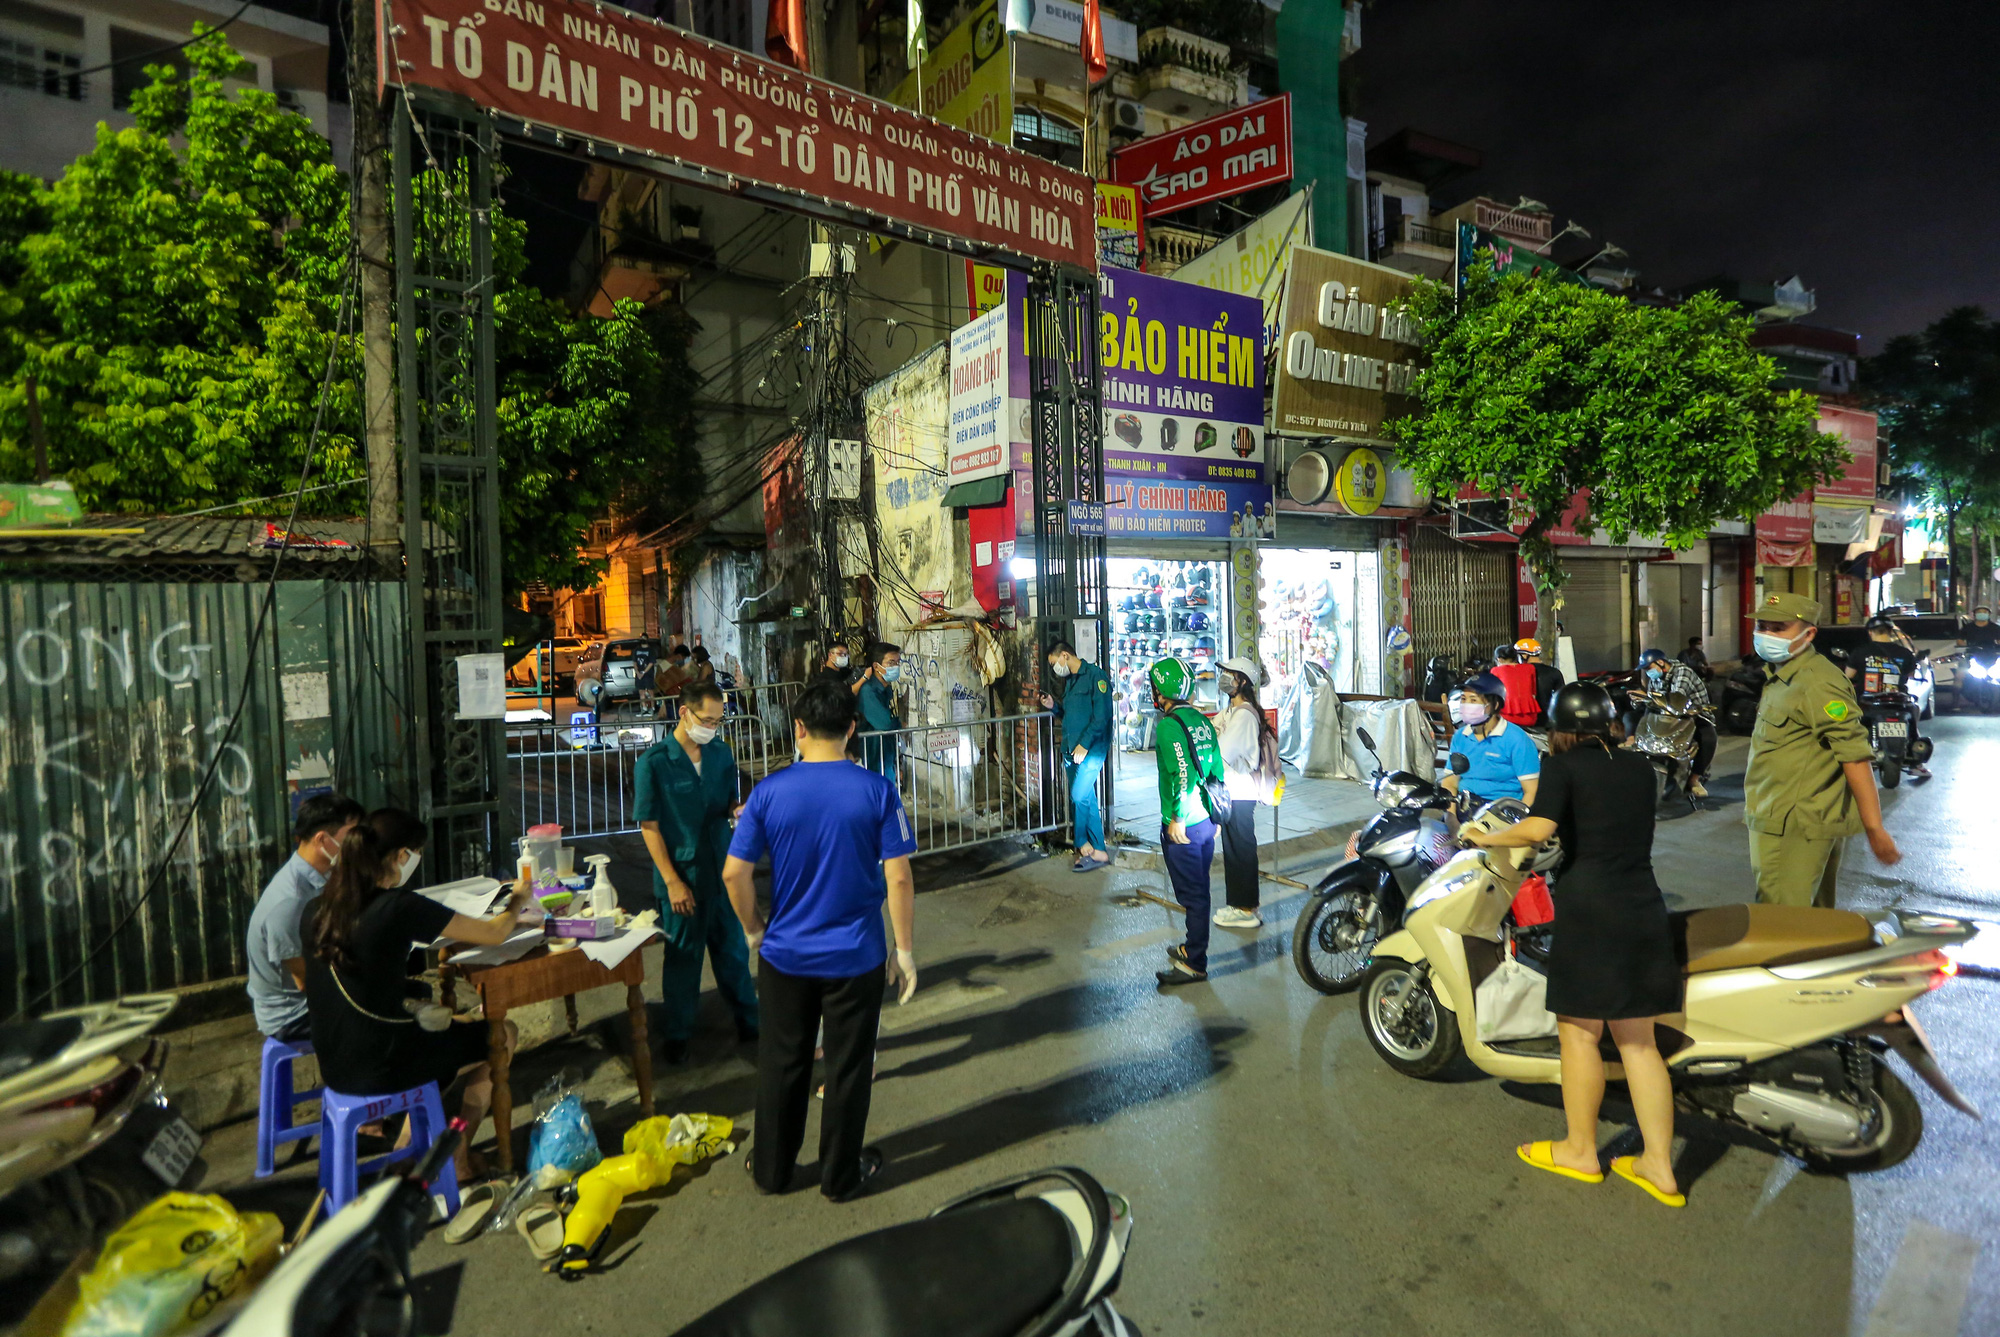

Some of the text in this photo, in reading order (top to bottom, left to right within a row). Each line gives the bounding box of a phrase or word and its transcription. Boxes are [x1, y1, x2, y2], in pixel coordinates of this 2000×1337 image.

[563, 12, 640, 60] NHÂN
[653, 43, 706, 81] DÂN
[721, 67, 818, 120] PHƯỜNG
[830, 102, 872, 136] VĂN
[1008, 162, 1032, 190] HÀ
[1040, 176, 1085, 208] ĐÔNG
[422, 11, 487, 80] TỔ
[506, 41, 600, 113] DÂN
[619, 75, 702, 141] PHỐ
[833, 142, 896, 198] DÂN
[907, 165, 963, 218] PHỐ
[971, 178, 1021, 236] VĂN
[1030, 203, 1075, 251] HÓA
[1172, 114, 1266, 162] ÁO DÀI
[1150, 143, 1278, 201] SAO MAI
[1110, 193, 1133, 226] NỘI
[1317, 280, 1376, 337] GẤU
[1101, 295, 1167, 375] BẢO
[1177, 311, 1255, 389] HIỂM
[953, 346, 1002, 398] HOÀNG ĐẠT
[1286, 330, 1384, 391] ONLINE
[953, 393, 1002, 426] ĐIỆN CÔNG NGHIỆP
[1156, 385, 1214, 413] HÃNG
[956, 419, 997, 445] ĐIỆN DÂN DỤNG
[1107, 458, 1131, 471] THANH
[1132, 459, 1151, 473] XUÂN
[1157, 462, 1167, 473] HN
[1071, 502, 1103, 520] NGÕ 565
[1115, 480, 1135, 510] LÝ
[1138, 482, 1185, 512] CHÍNH
[1188, 485, 1228, 514] HÃNG
[1108, 511, 1206, 533] MŨ BẢO HIỂM PROTEC
[1520, 601, 1538, 623] THUÊ
[1153, 667, 1165, 685] Grab
